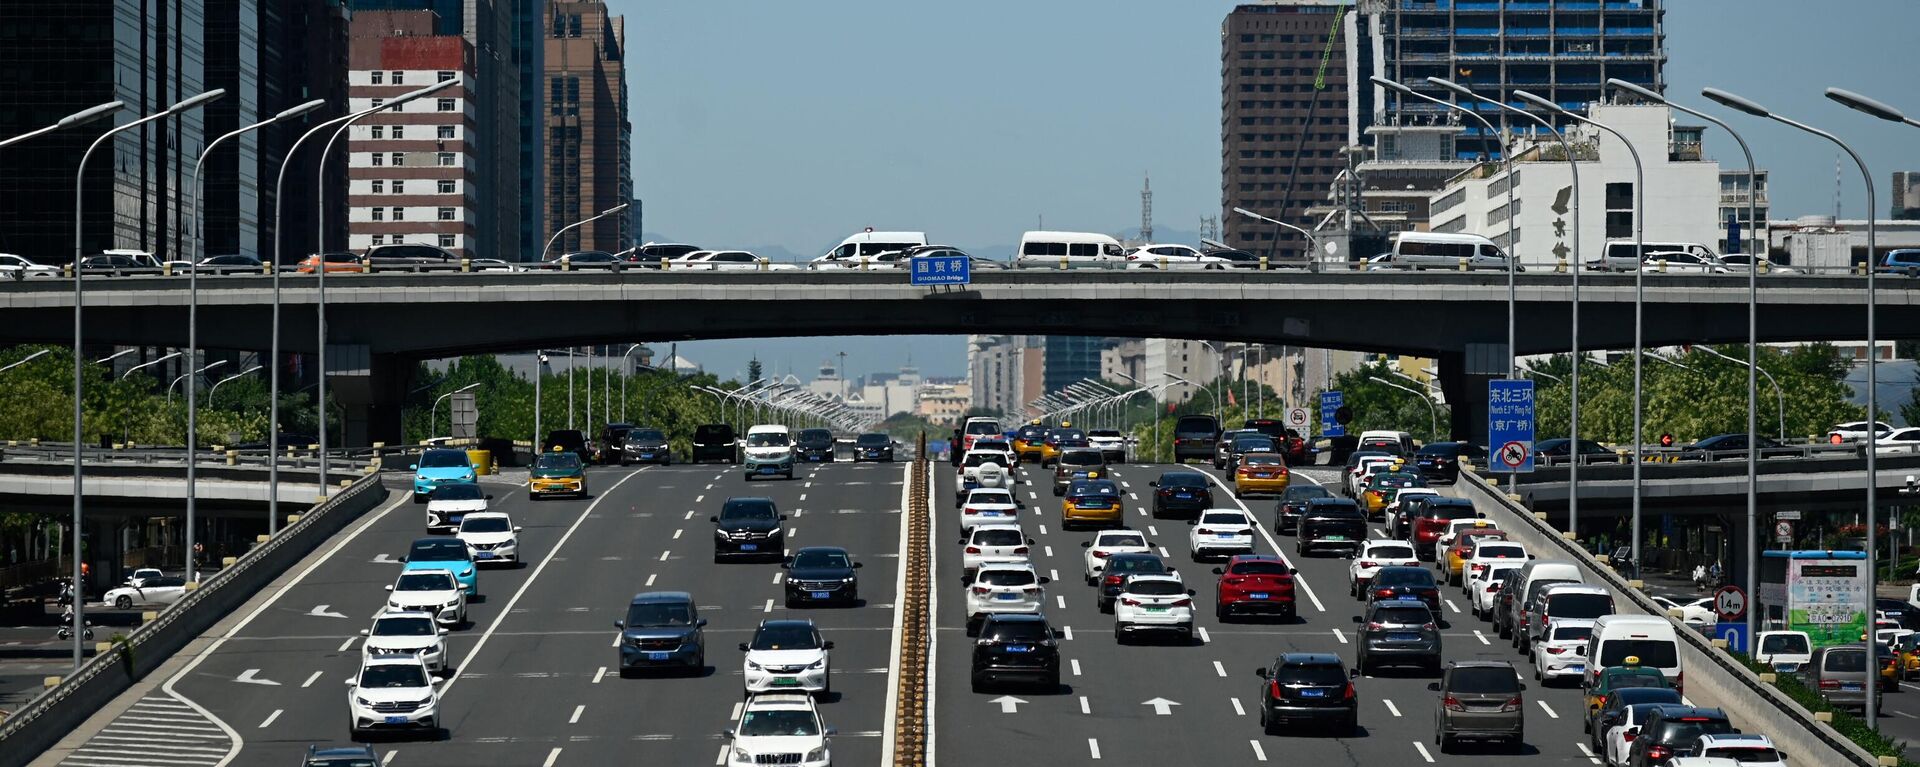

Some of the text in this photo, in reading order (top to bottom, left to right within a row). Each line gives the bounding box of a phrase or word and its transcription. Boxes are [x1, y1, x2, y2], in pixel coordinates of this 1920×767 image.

[917, 260, 962, 273] 国贸桥
[1490, 388, 1533, 403] 东北三环
[1491, 405, 1504, 415] North
[1515, 405, 1525, 417] Ring
[1525, 405, 1532, 415] Rd
[1490, 419, 1532, 431] (京广桥)
